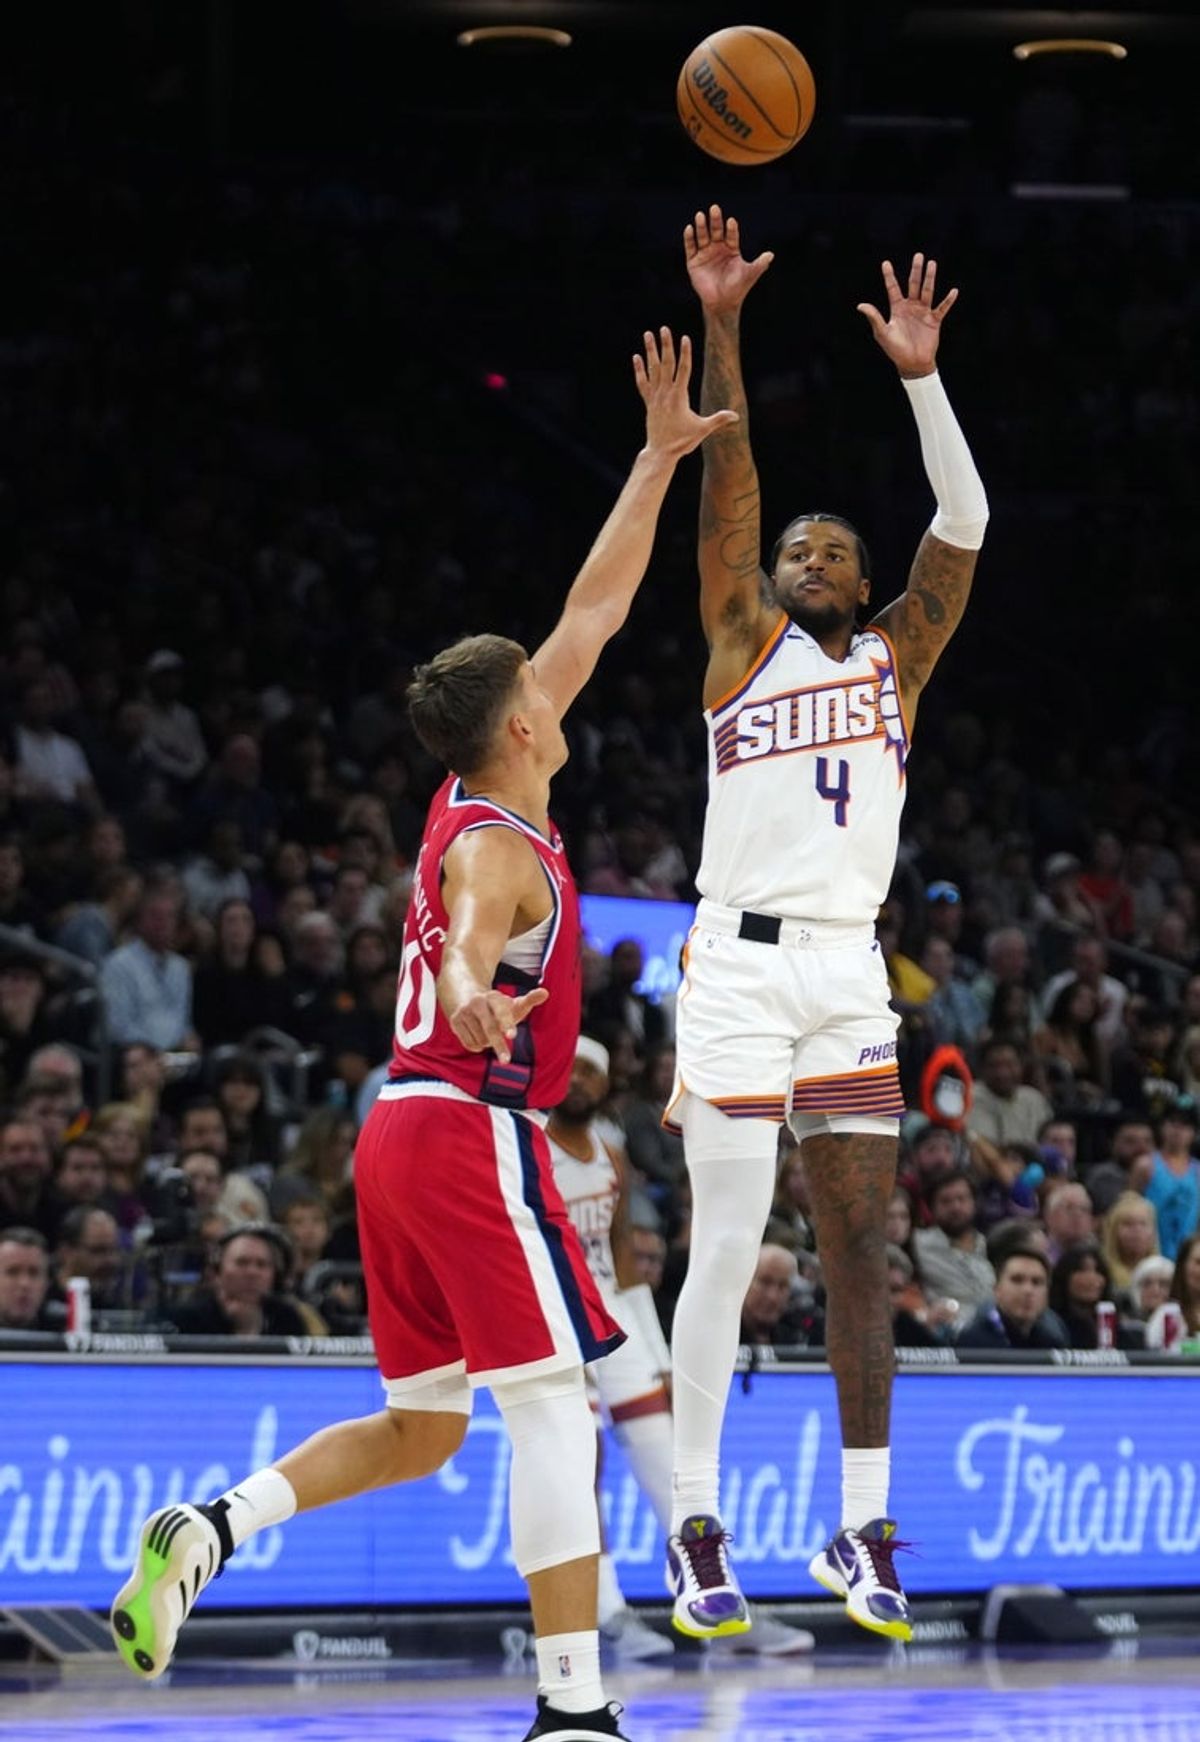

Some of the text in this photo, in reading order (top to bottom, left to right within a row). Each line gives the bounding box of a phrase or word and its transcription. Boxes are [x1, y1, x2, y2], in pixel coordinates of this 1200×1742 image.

[693, 59, 752, 139] Wilson
[736, 684, 877, 760] SUNS
[815, 756, 850, 828] 4
[319, 1636, 392, 1659] FANDUEL
